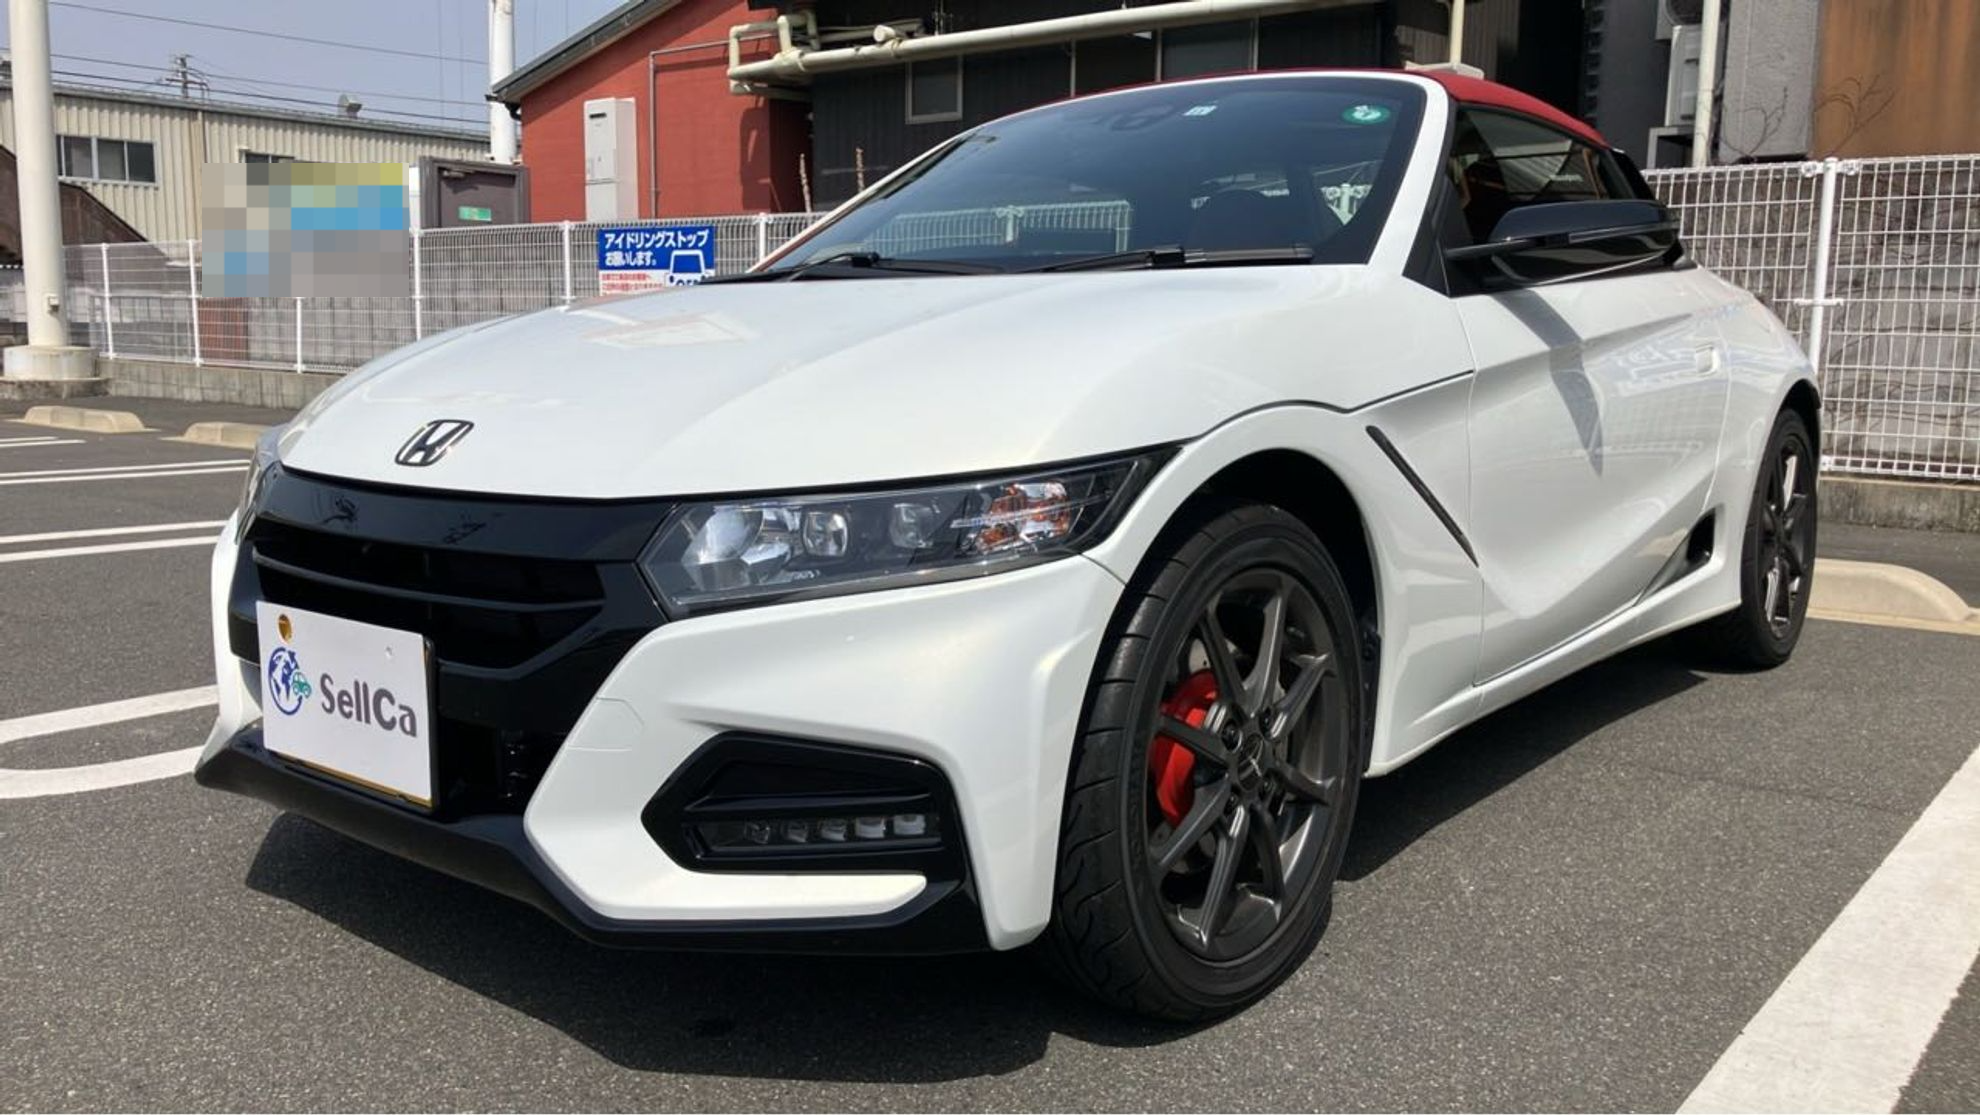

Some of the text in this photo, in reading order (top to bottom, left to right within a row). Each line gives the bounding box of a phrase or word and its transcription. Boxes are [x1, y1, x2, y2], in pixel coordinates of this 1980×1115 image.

[604, 229, 709, 249] アイドリングストップ
[320, 673, 418, 738] SellCa
